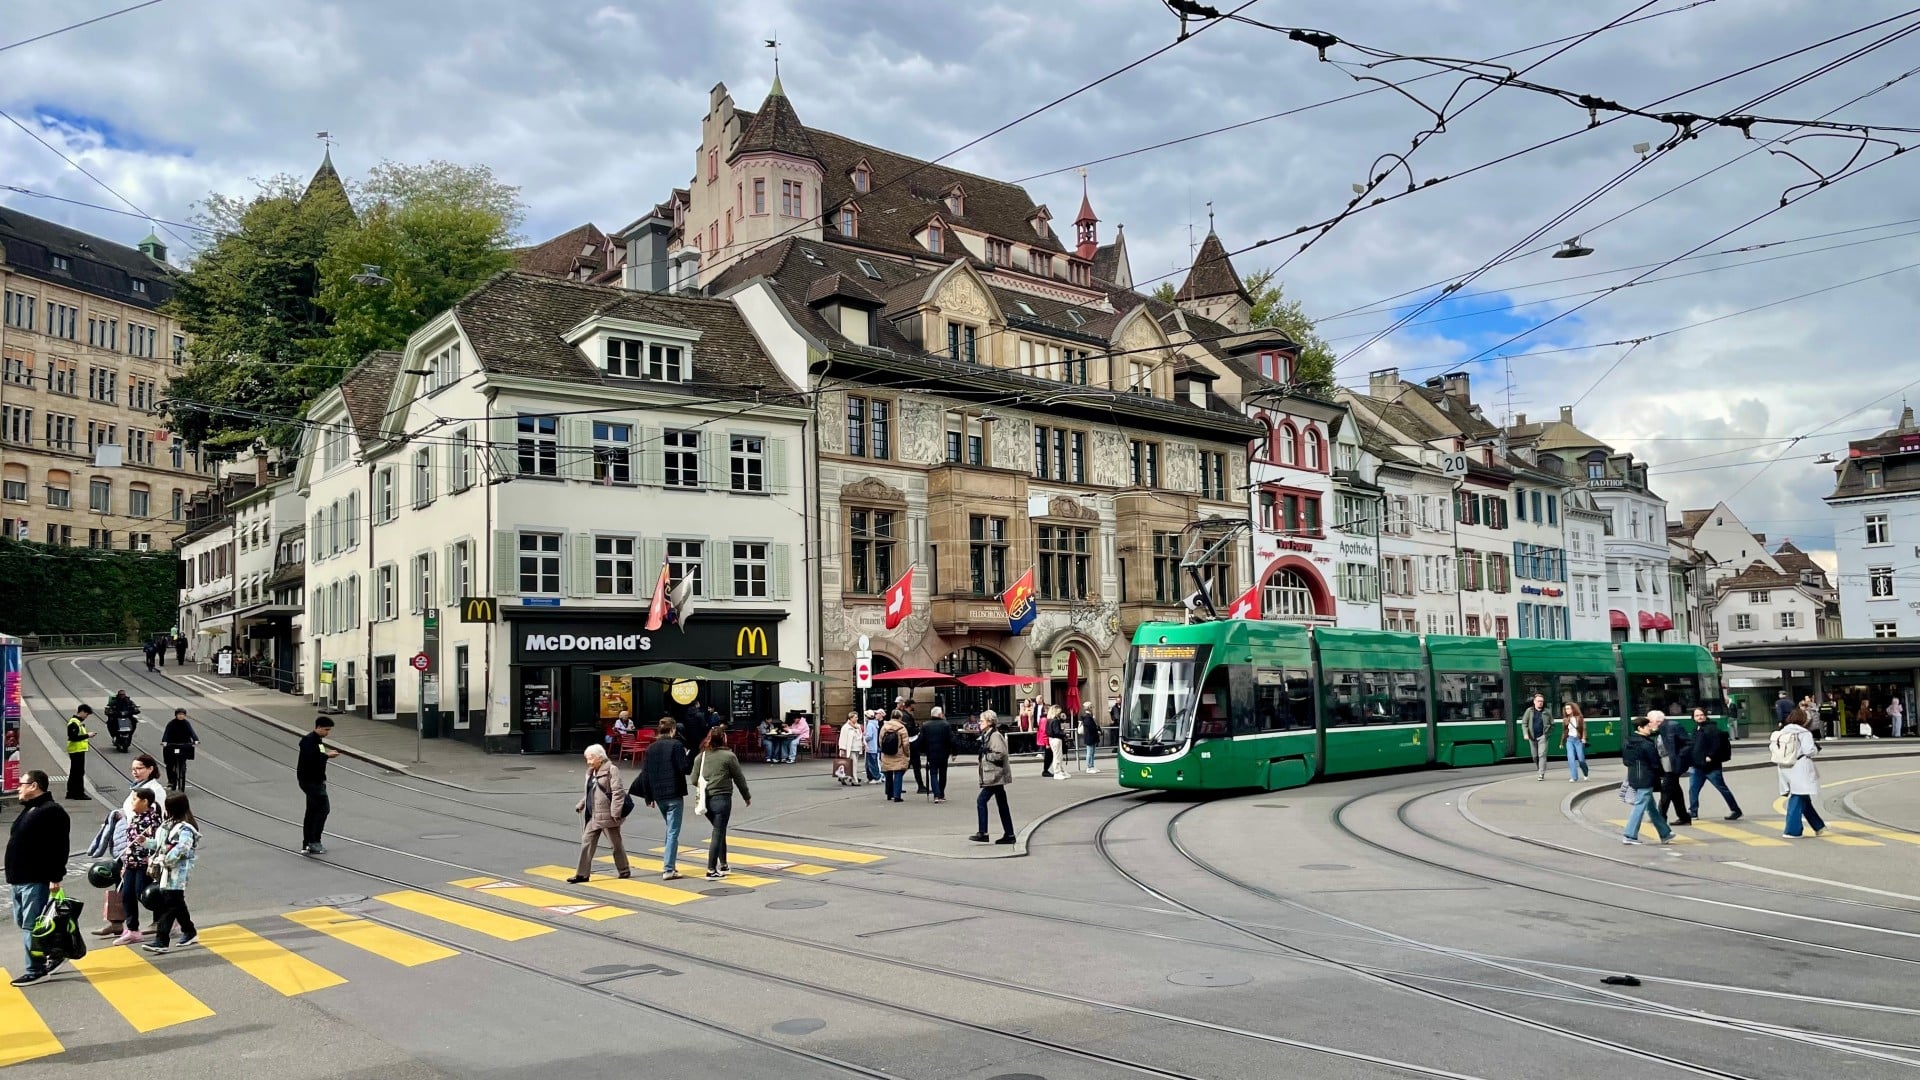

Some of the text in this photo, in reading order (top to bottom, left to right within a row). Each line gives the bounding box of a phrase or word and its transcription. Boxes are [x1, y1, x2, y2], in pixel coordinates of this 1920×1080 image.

[1444, 456, 1465, 473] 20
[1589, 479, 1624, 487] TADTHOF
[1339, 540, 1373, 557] Apotheke
[428, 609, 435, 619] B
[525, 634, 652, 651] McDonald's
